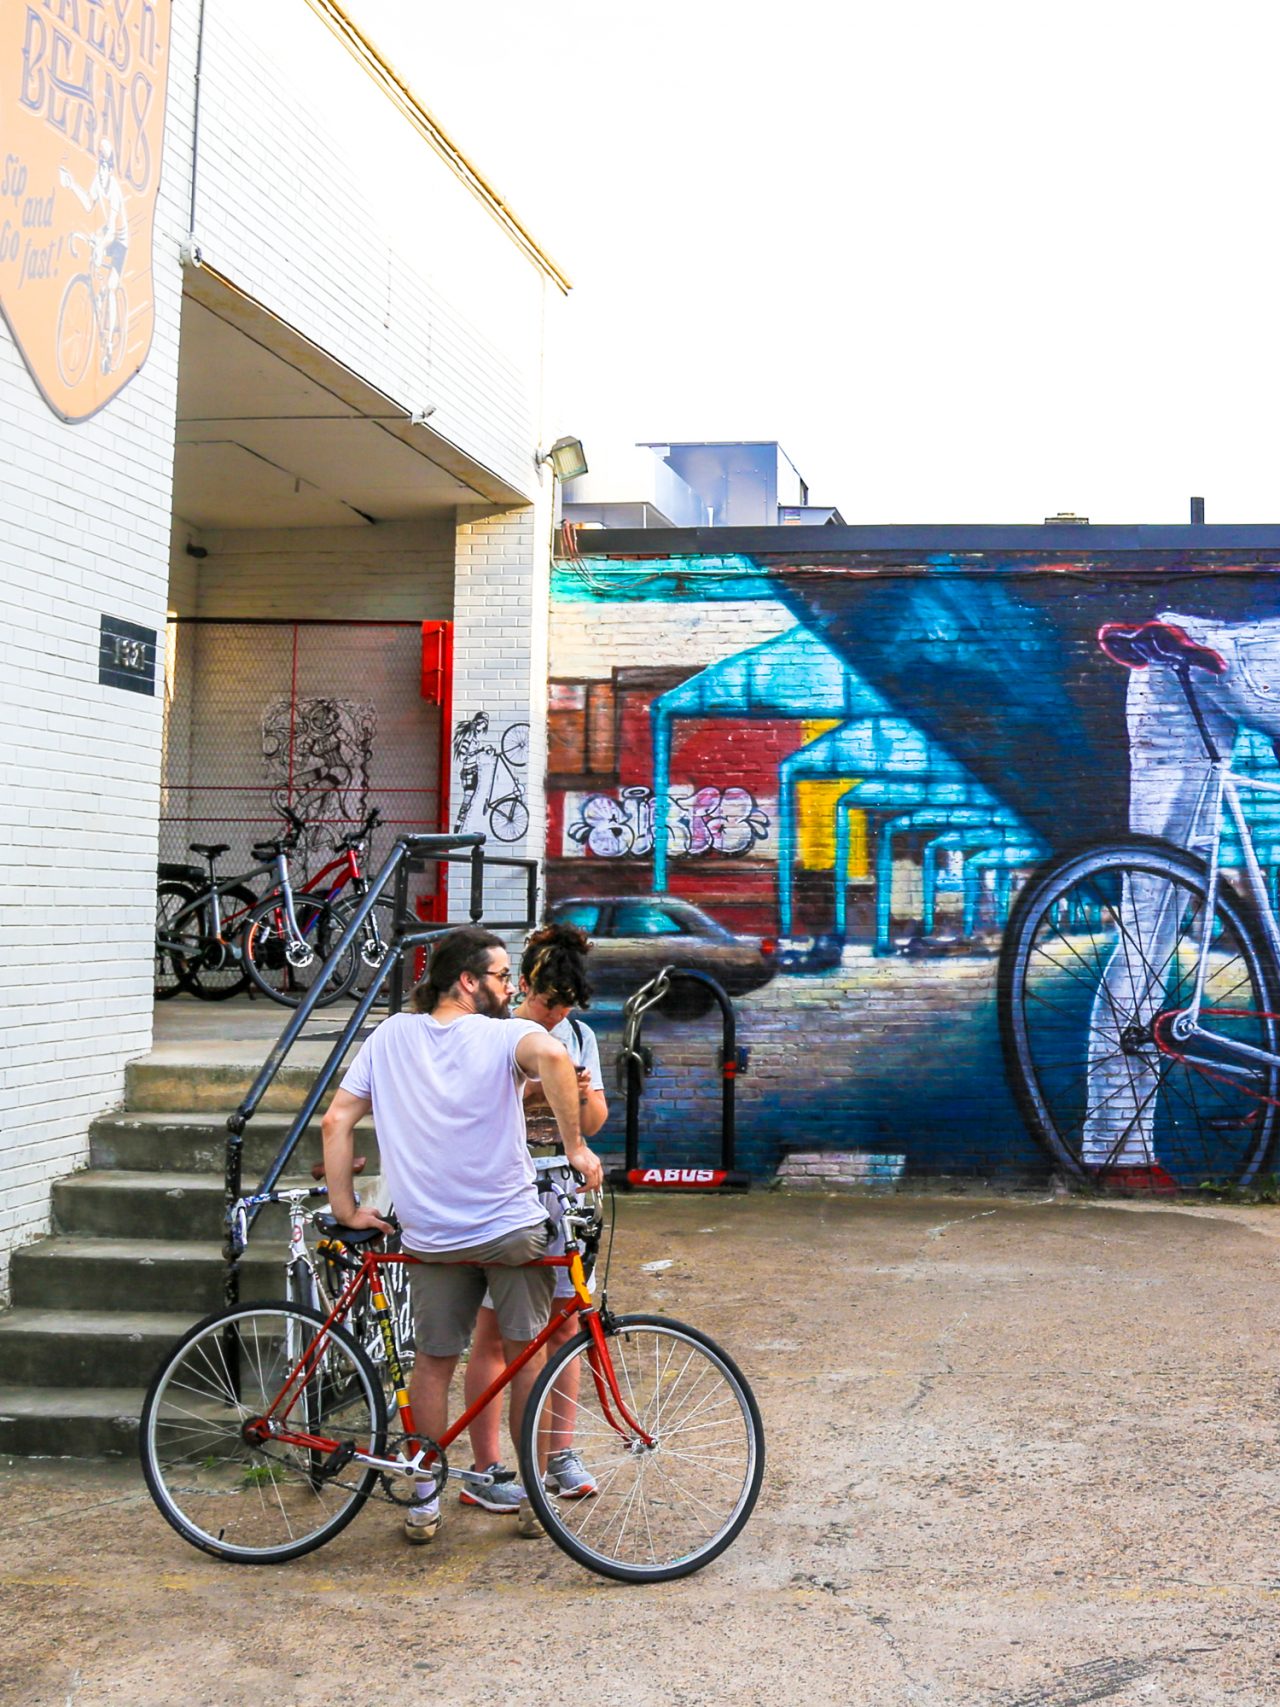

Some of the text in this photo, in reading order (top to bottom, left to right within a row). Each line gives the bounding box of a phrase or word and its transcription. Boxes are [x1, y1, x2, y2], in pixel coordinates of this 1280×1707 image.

[20, 5, 153, 192] BEANS
[1, 153, 56, 228] Sip and
[0, 219, 63, 290] Go fast!
[643, 1168, 715, 1182] ABUS
